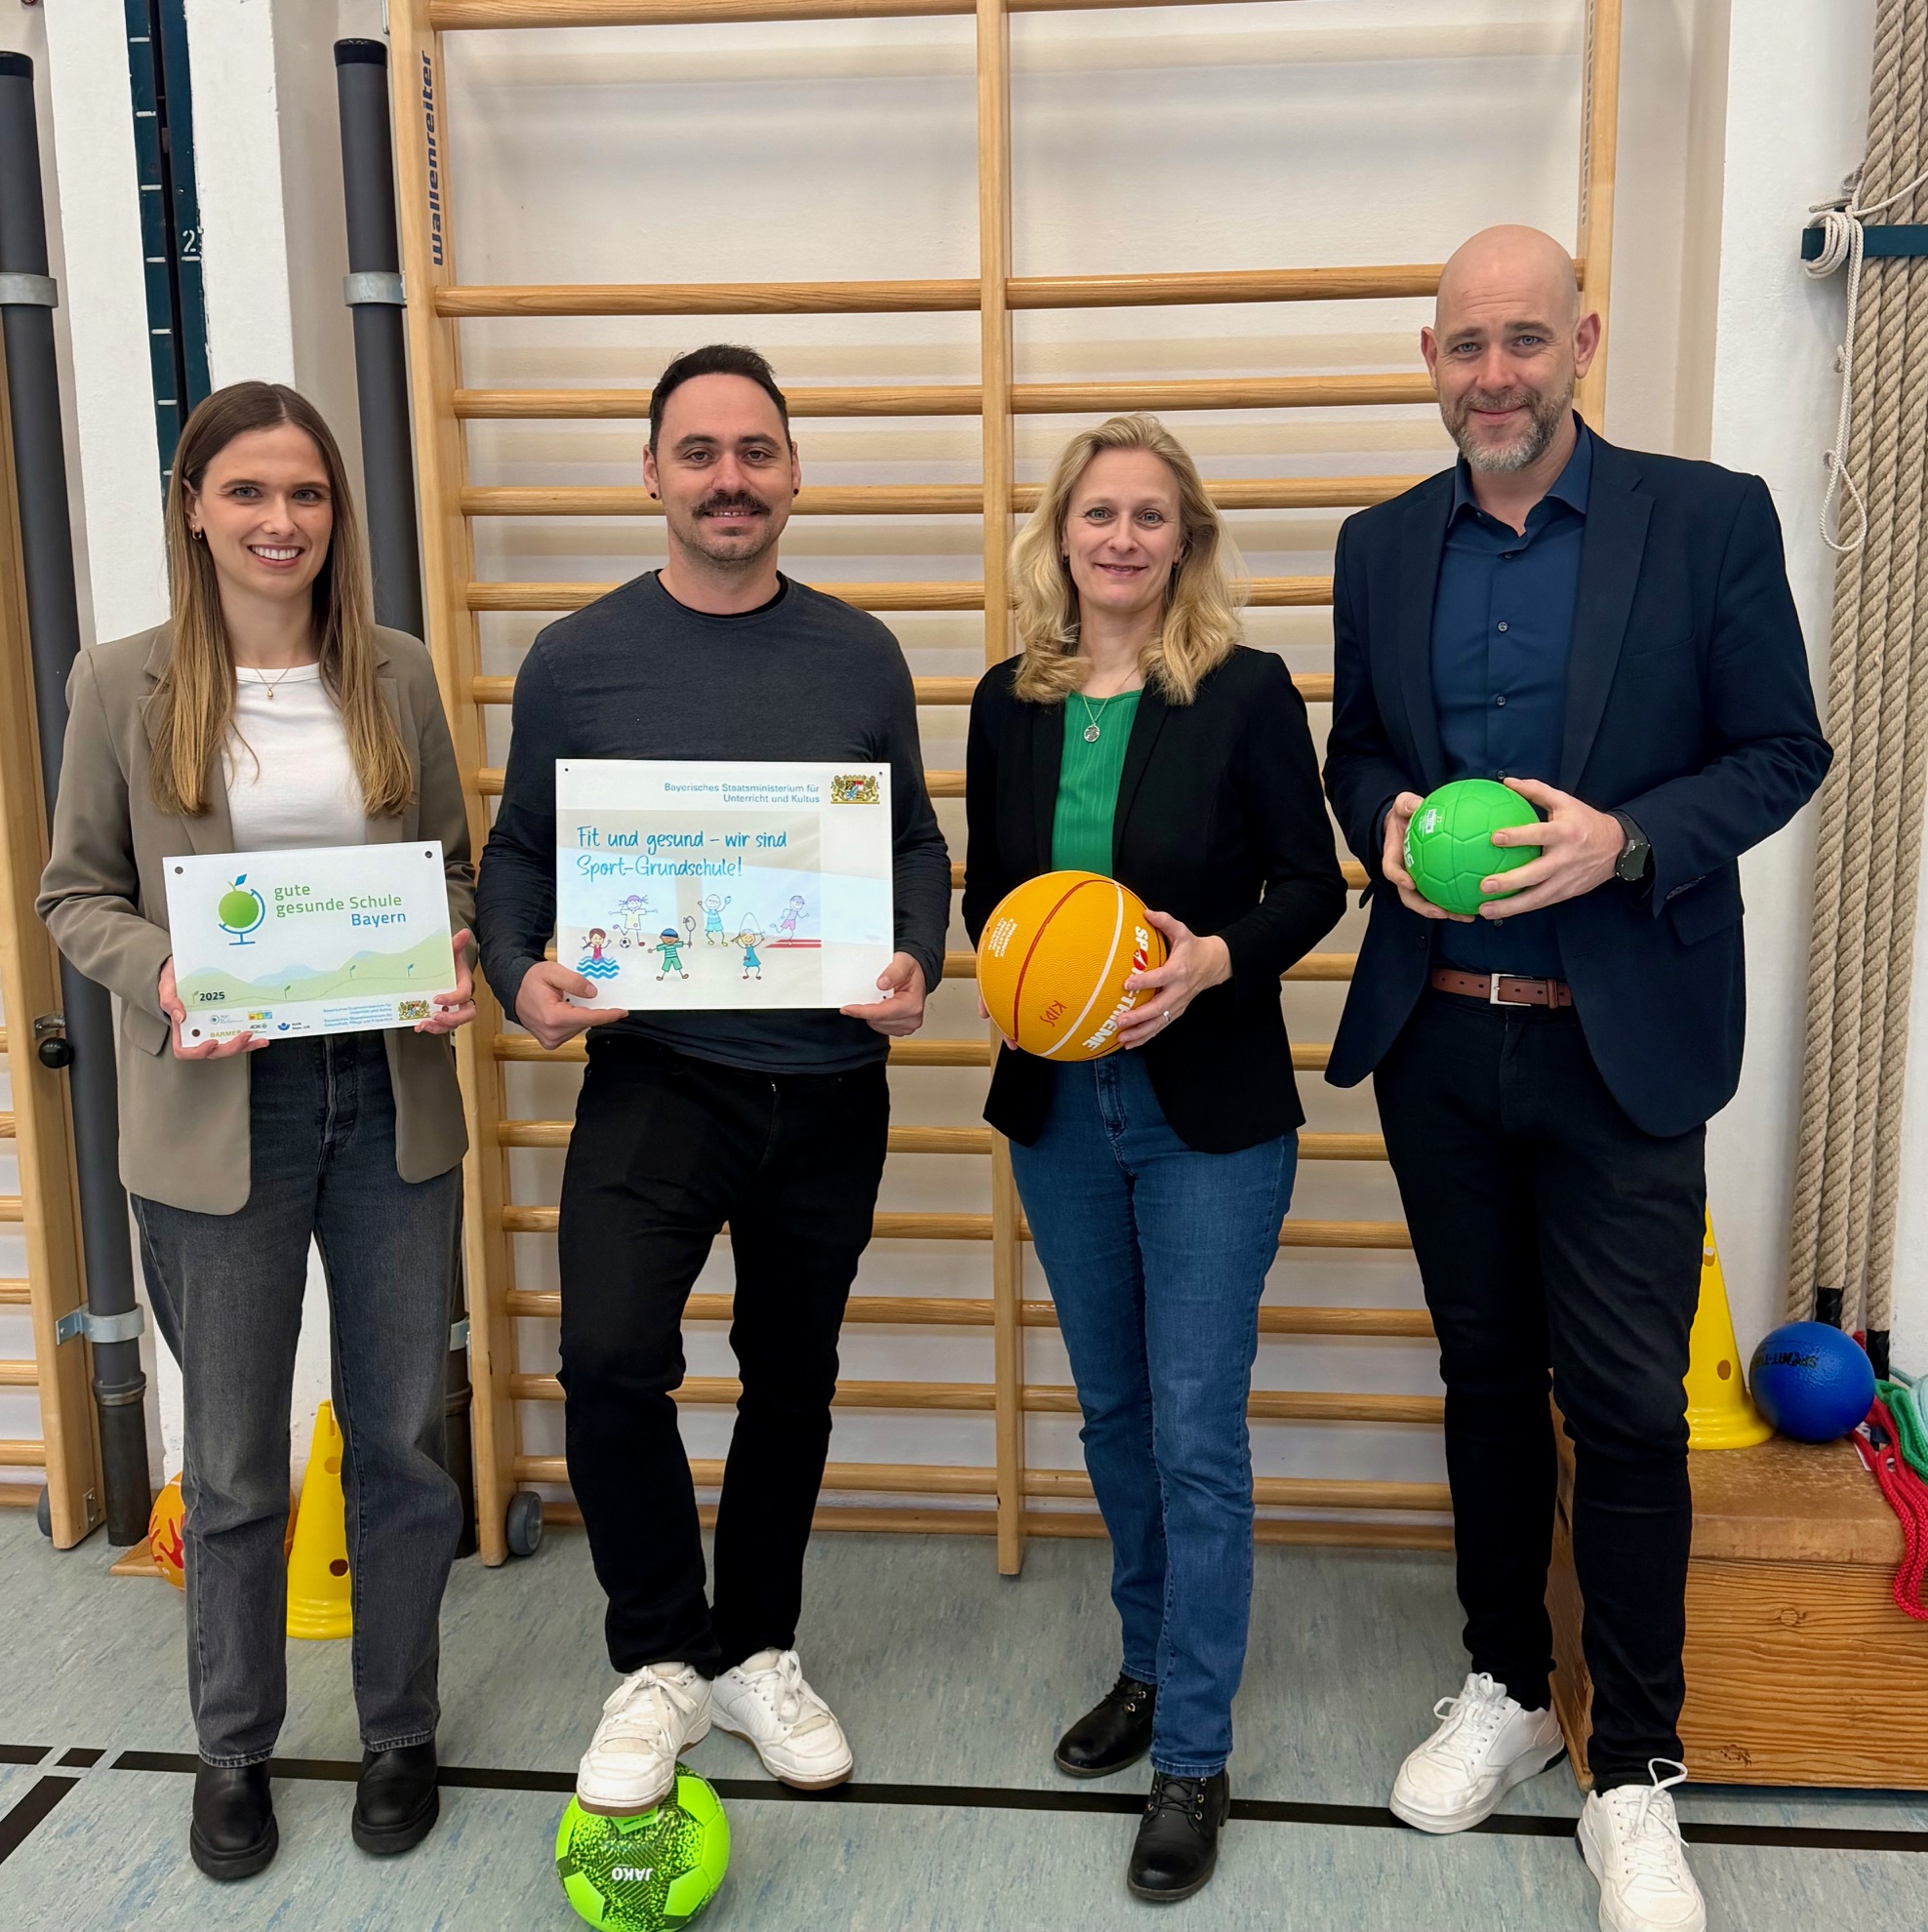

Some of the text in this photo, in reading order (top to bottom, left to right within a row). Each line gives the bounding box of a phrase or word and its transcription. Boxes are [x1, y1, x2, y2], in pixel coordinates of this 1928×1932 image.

[422, 50, 443, 266] wallenreiter
[181, 229, 197, 252] 2
[663, 783, 820, 795] Bayerisches Staatsministerium für
[723, 794, 821, 804] Unterricht und Kultus
[577, 825, 601, 848] Fit
[607, 829, 639, 848] und
[646, 830, 704, 856] gesund
[724, 831, 750, 848] wir
[755, 831, 787, 848] sind
[576, 854, 743, 883] Sport-Grundschule!
[274, 879, 311, 901] gute
[275, 894, 402, 918] gesunde Schule
[351, 912, 407, 928] Bayern
[199, 990, 225, 1002] 2025
[1039, 999, 1067, 1027] KIDS
[611, 1867, 654, 1881] JAKO
